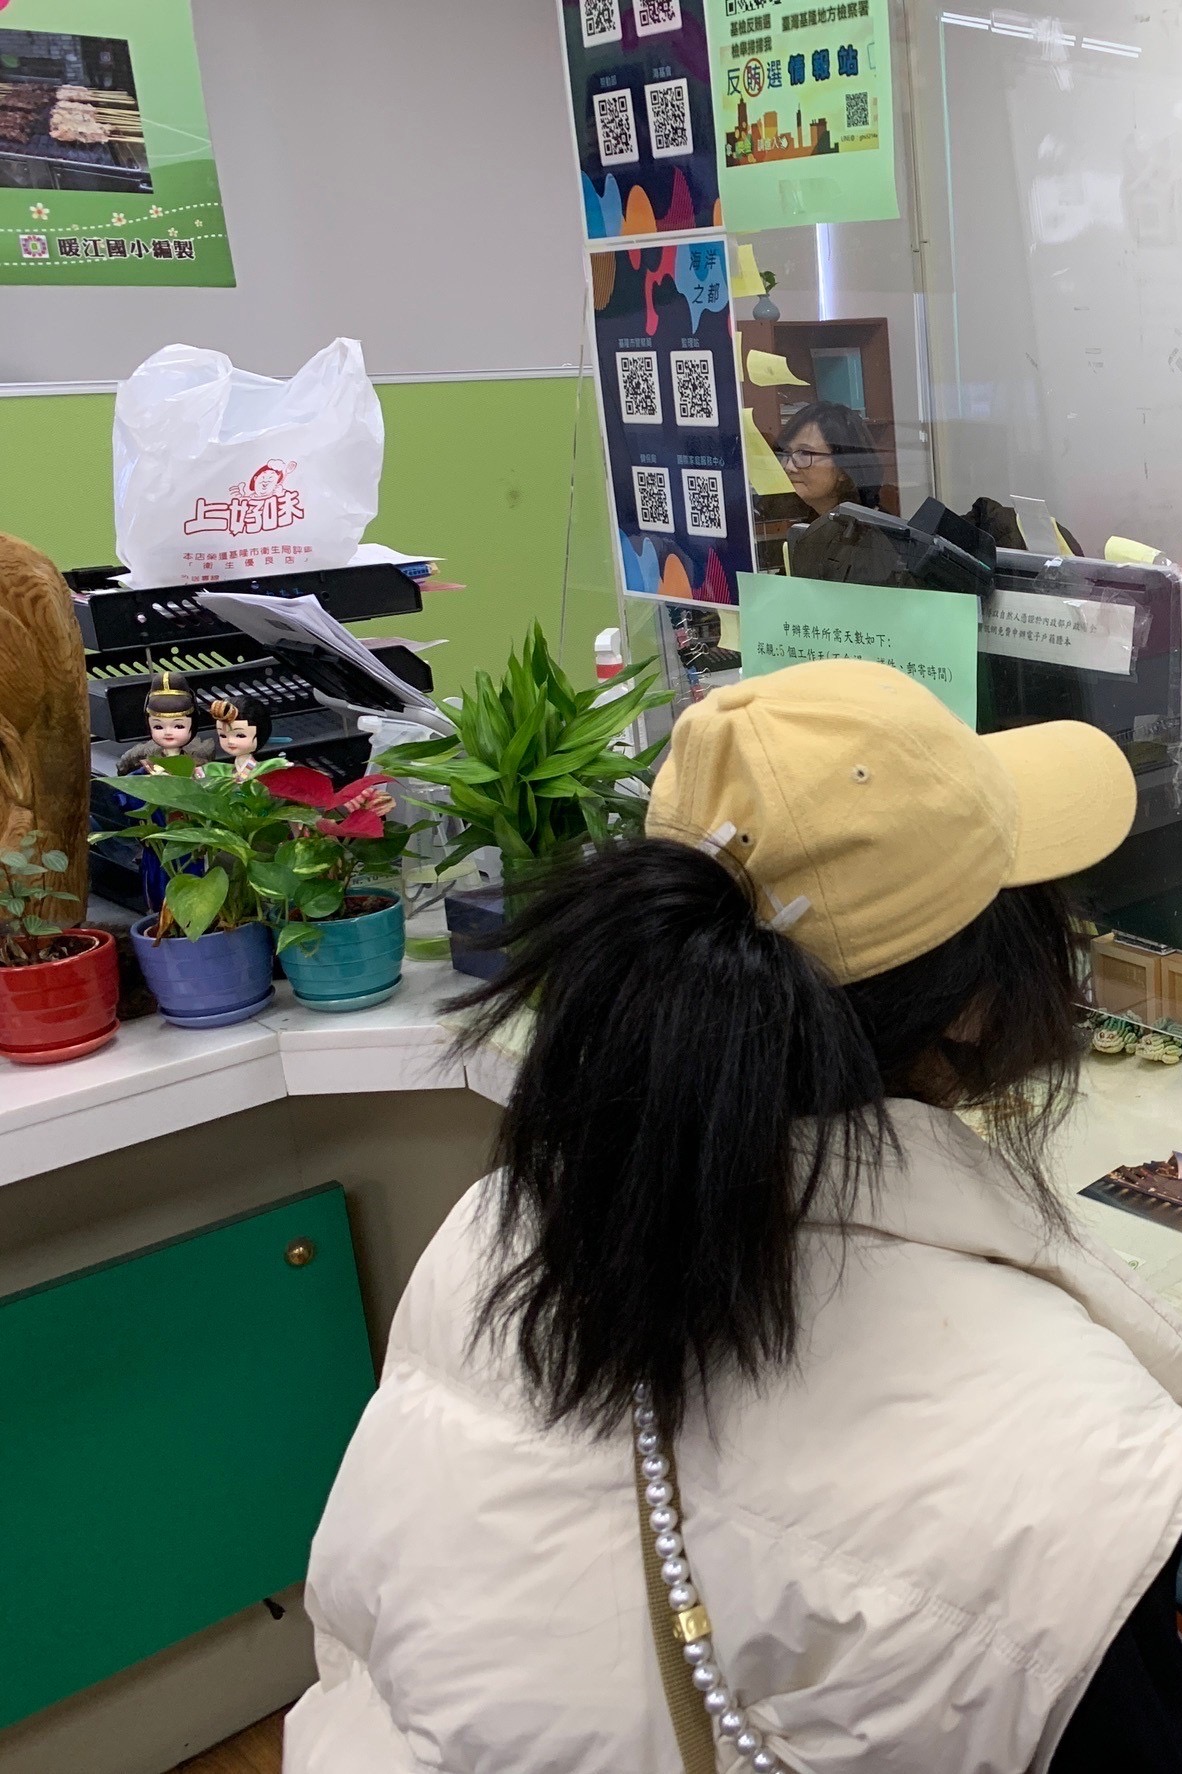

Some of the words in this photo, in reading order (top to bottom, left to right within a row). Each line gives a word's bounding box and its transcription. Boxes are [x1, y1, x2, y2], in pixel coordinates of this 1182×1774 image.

[57, 237, 195, 260] 暖江國小編製
[184, 491, 304, 536] 上好味
